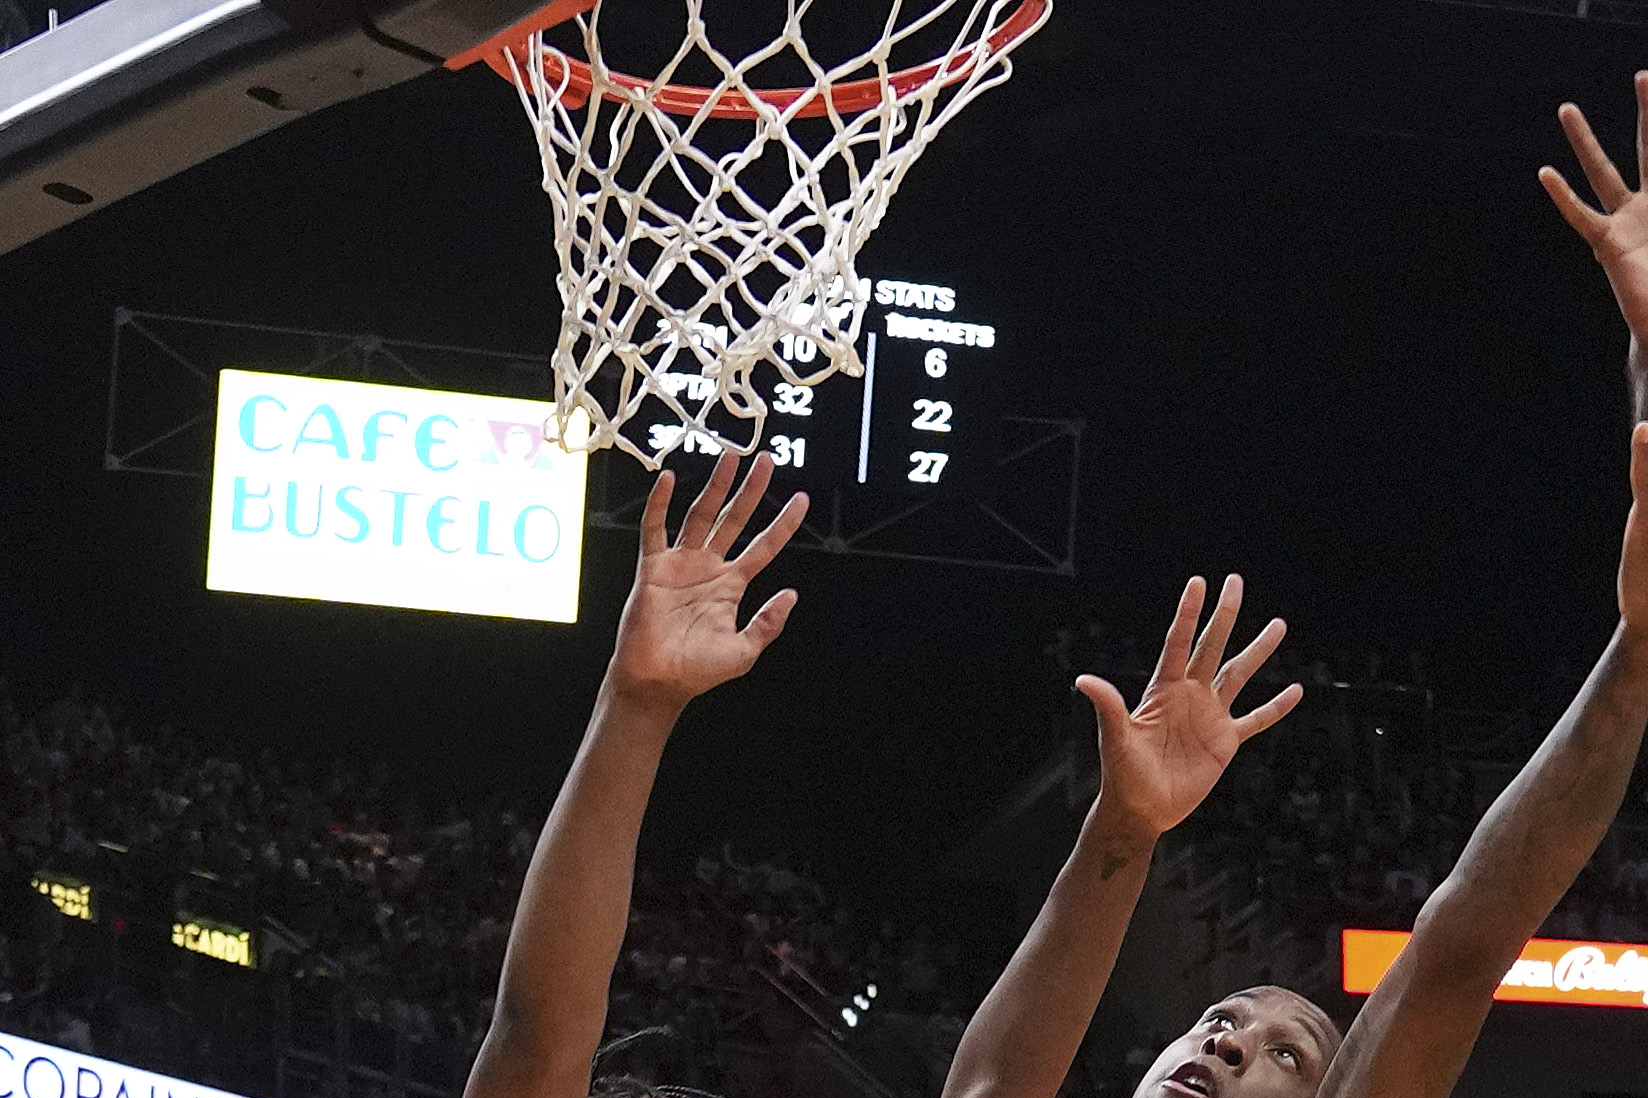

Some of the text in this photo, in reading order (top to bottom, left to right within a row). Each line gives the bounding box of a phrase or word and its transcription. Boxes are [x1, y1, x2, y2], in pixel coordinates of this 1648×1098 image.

[874, 279, 957, 312] STATS
[780, 333, 818, 363] 10
[924, 348, 948, 378] 6
[772, 383, 814, 416] 32
[911, 398, 953, 432] 22
[769, 434, 806, 468] 31
[907, 451, 949, 484] 27
[231, 475, 561, 563] BUSTELO
